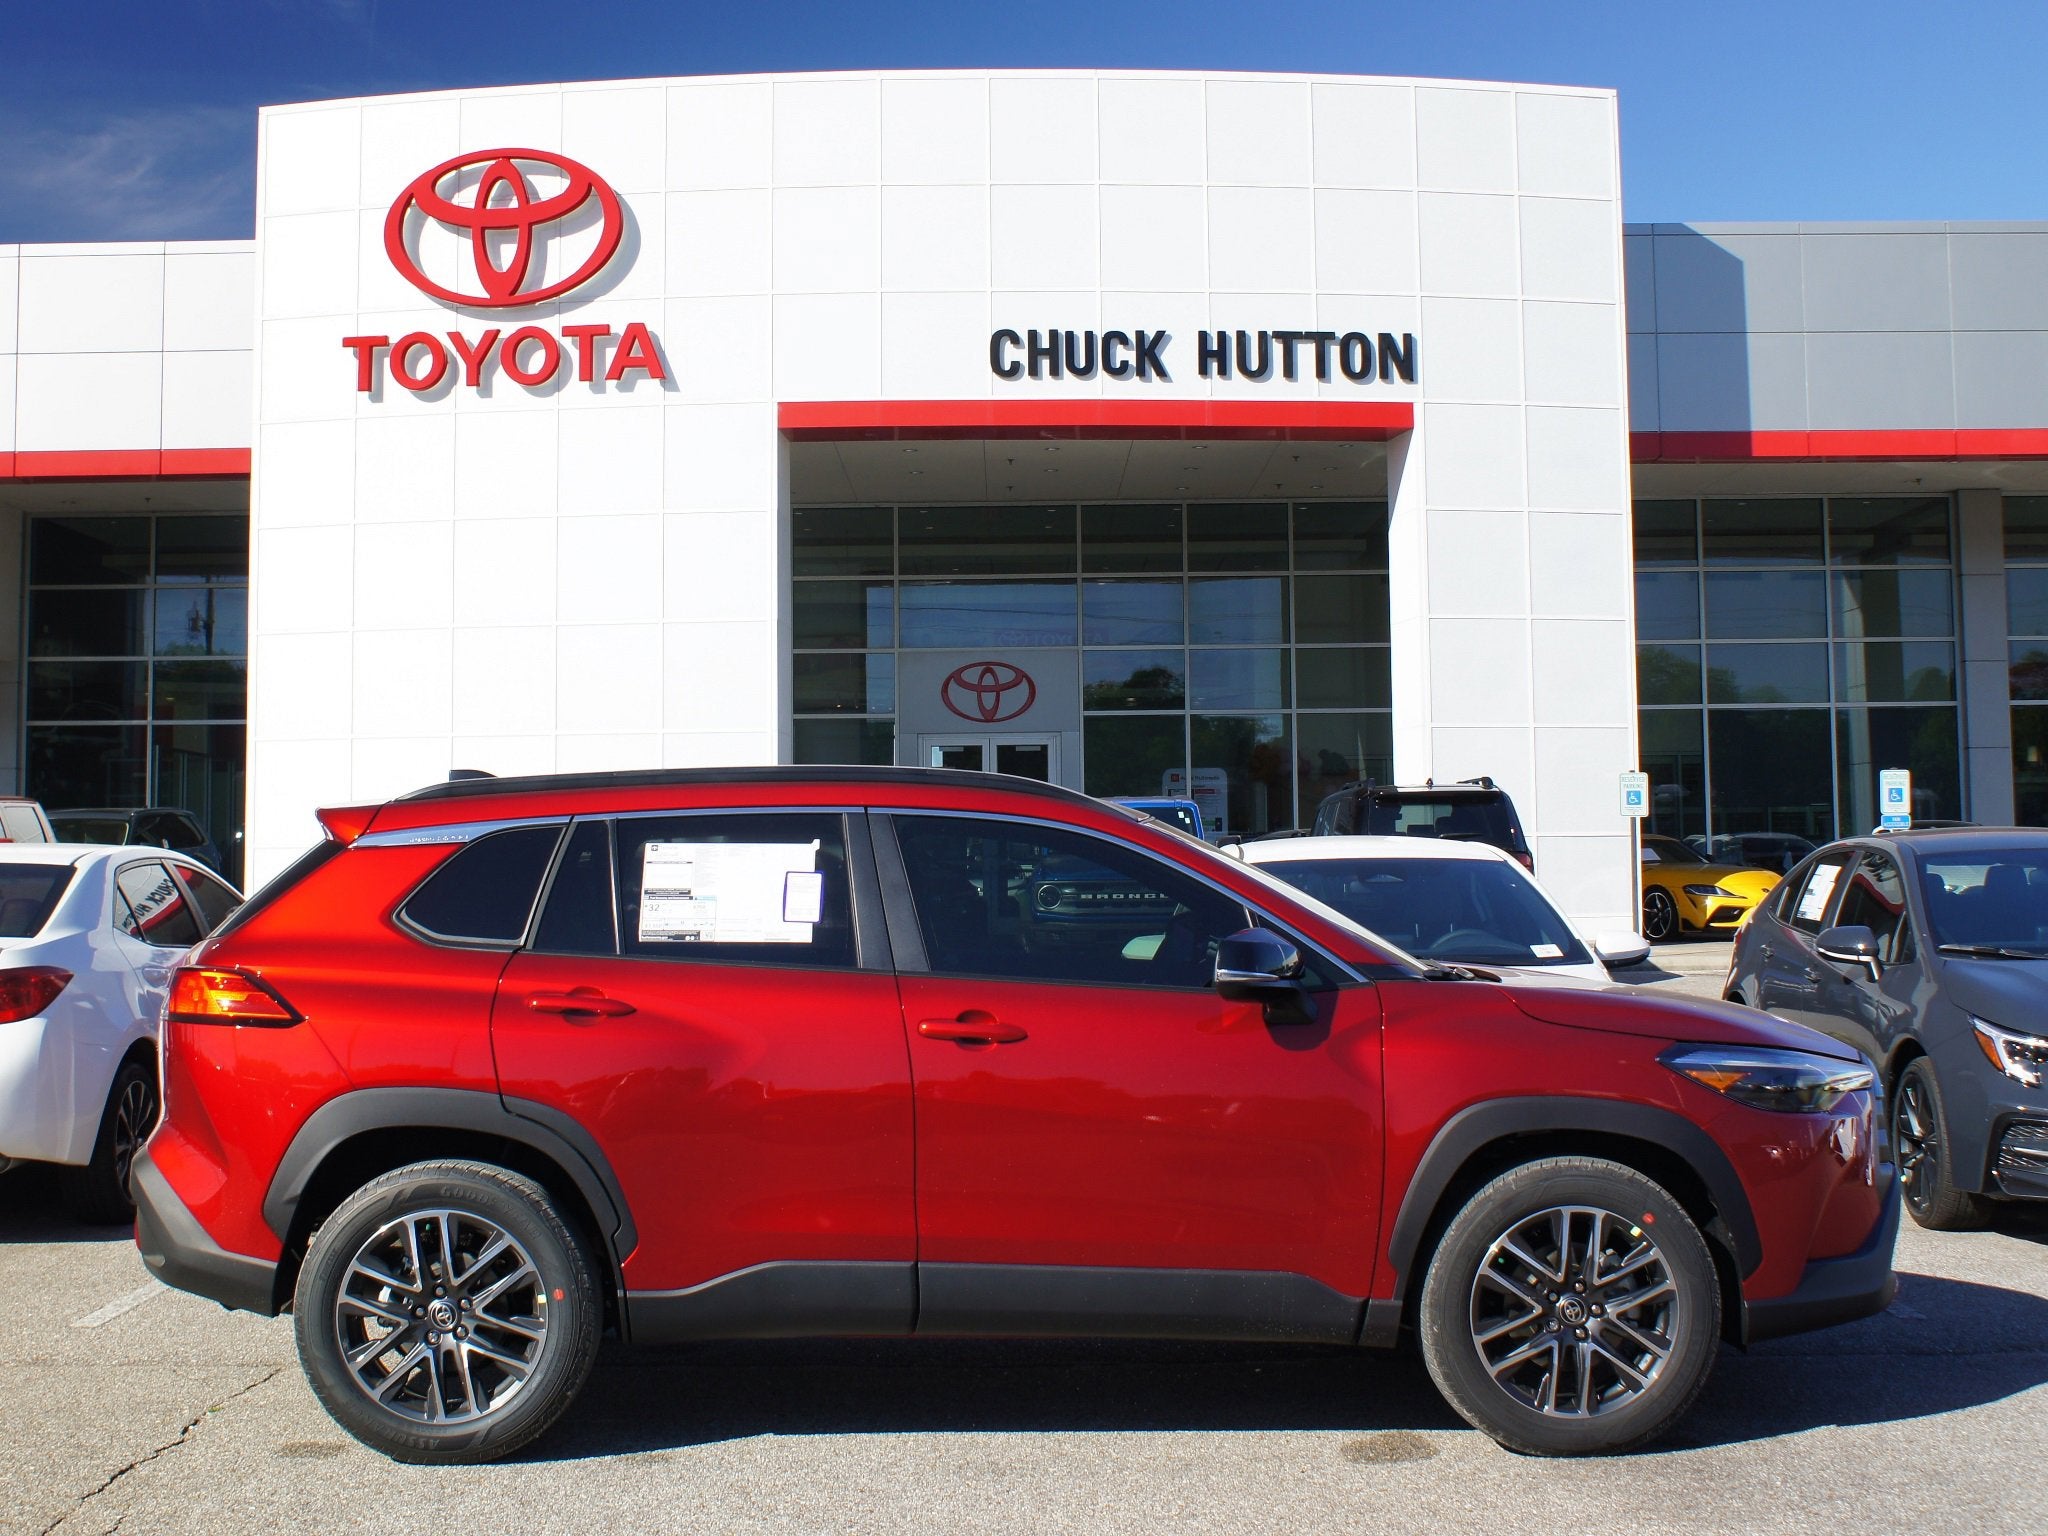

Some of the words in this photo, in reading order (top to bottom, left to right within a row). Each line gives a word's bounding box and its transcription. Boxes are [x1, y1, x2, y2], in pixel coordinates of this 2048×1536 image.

[342, 322, 666, 392] TOYOTA
[989, 329, 1168, 379] CHUCK
[1198, 330, 1415, 382] HUTTON
